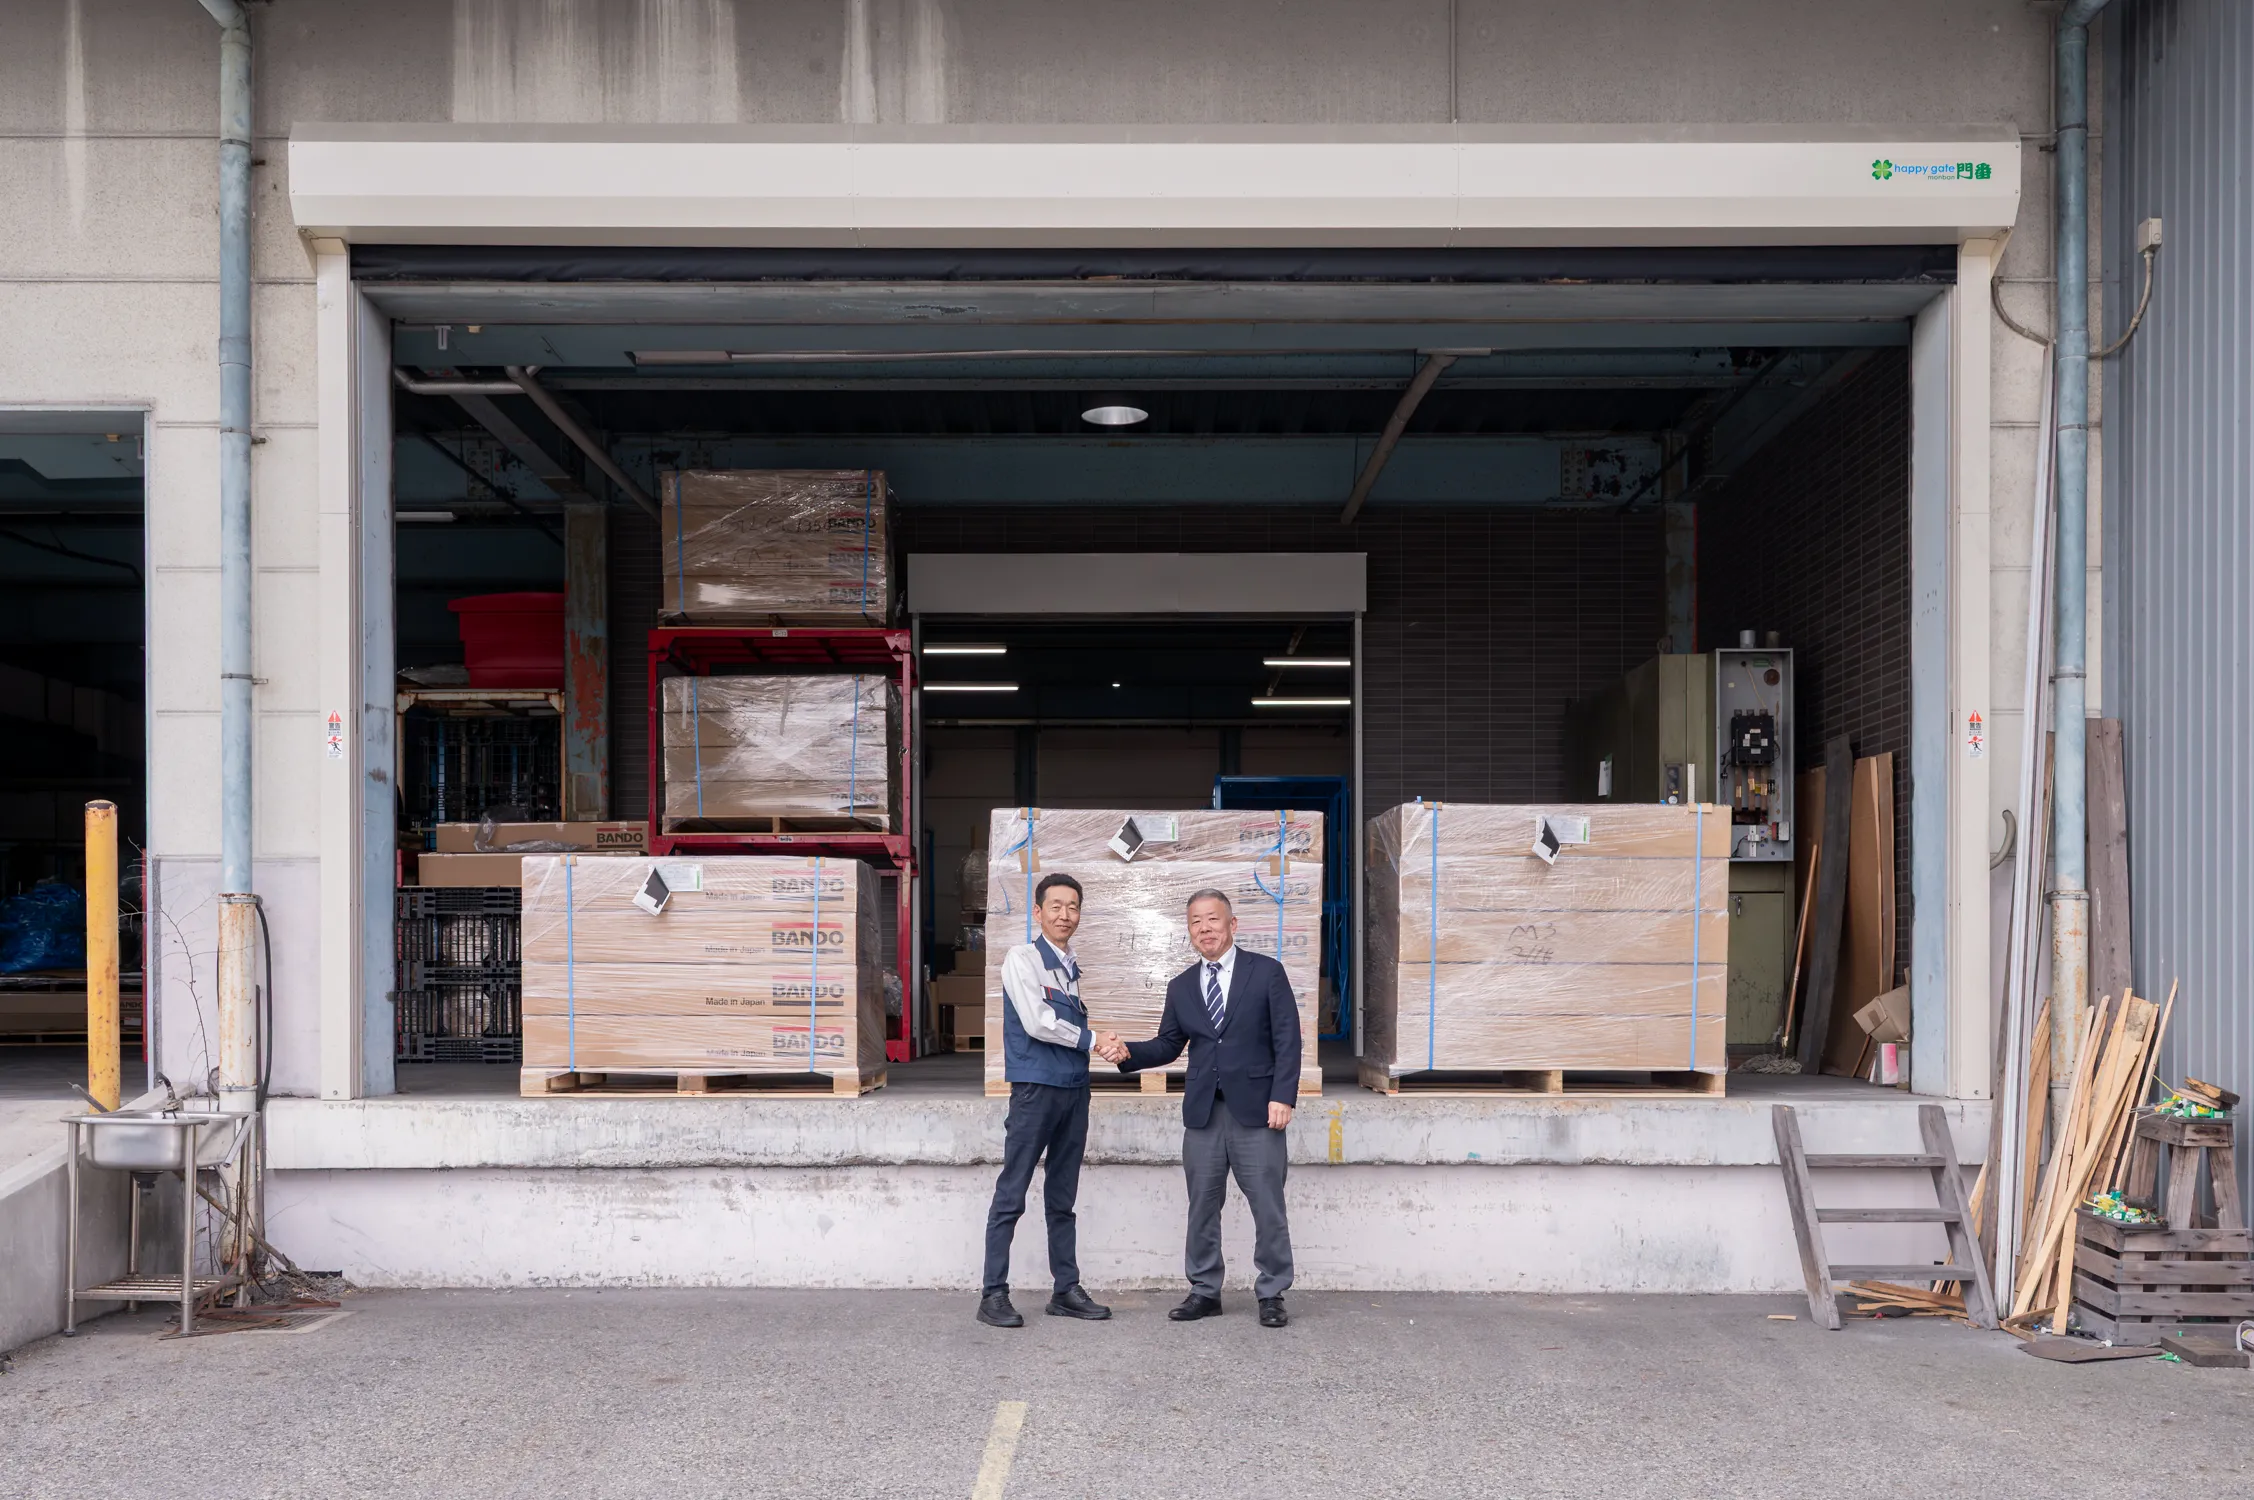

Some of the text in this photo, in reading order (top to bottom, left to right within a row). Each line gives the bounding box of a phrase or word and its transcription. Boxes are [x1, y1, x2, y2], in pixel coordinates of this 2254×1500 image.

[1894, 164, 1955, 174] happy gate
[1956, 162, 1992, 180] 門番
[596, 832, 643, 844] BANDO
[772, 878, 845, 893] BANDO
[772, 930, 844, 946] BANDO
[772, 983, 845, 998] BANDO
[705, 997, 766, 1008] Made in Japan
[772, 1034, 845, 1049] BANDO
